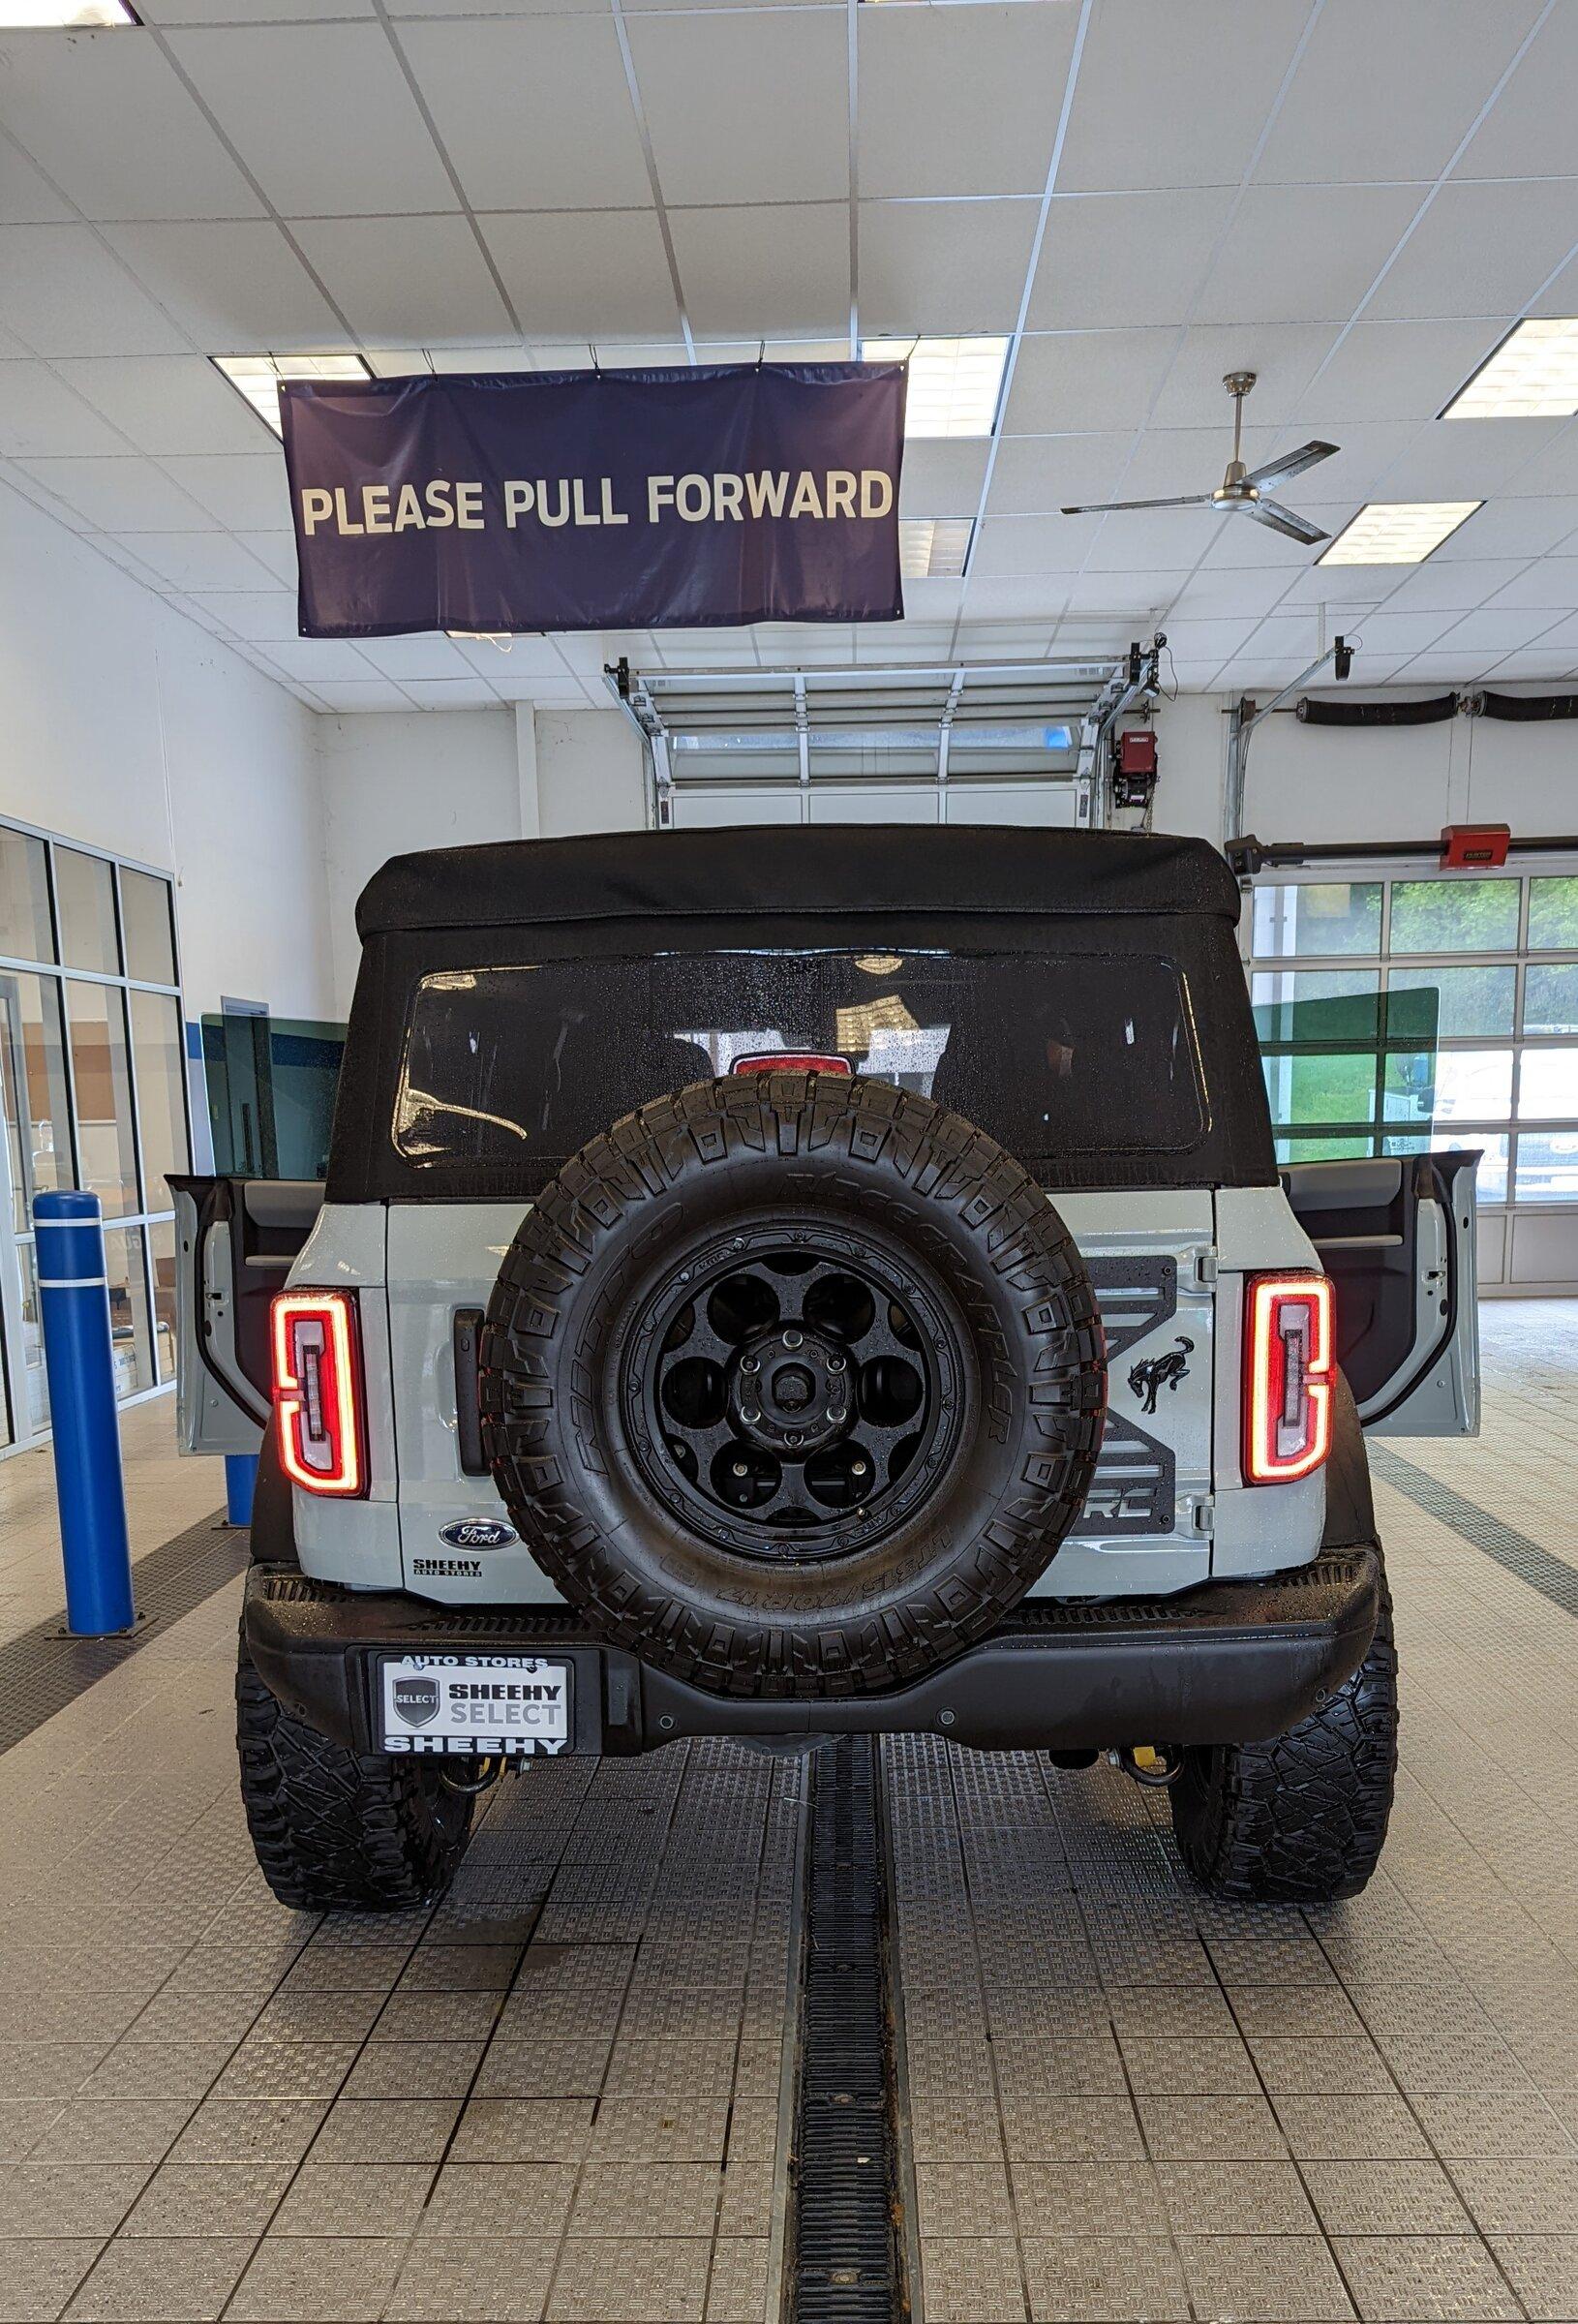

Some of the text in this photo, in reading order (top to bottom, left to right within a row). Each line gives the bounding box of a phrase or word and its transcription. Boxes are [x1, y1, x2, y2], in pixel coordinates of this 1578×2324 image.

[302, 470, 894, 536] PLEASE PULL FORWARD
[457, 1526, 501, 1544] Ford
[412, 1559, 481, 1571] SHEEHY
[401, 1655, 549, 1668] AUTO STORES
[395, 1695, 437, 1704] SELECT
[448, 1683, 561, 1700] SHEEHY
[450, 1702, 561, 1725] SELECT
[384, 1736, 568, 1755] SHEEHY
